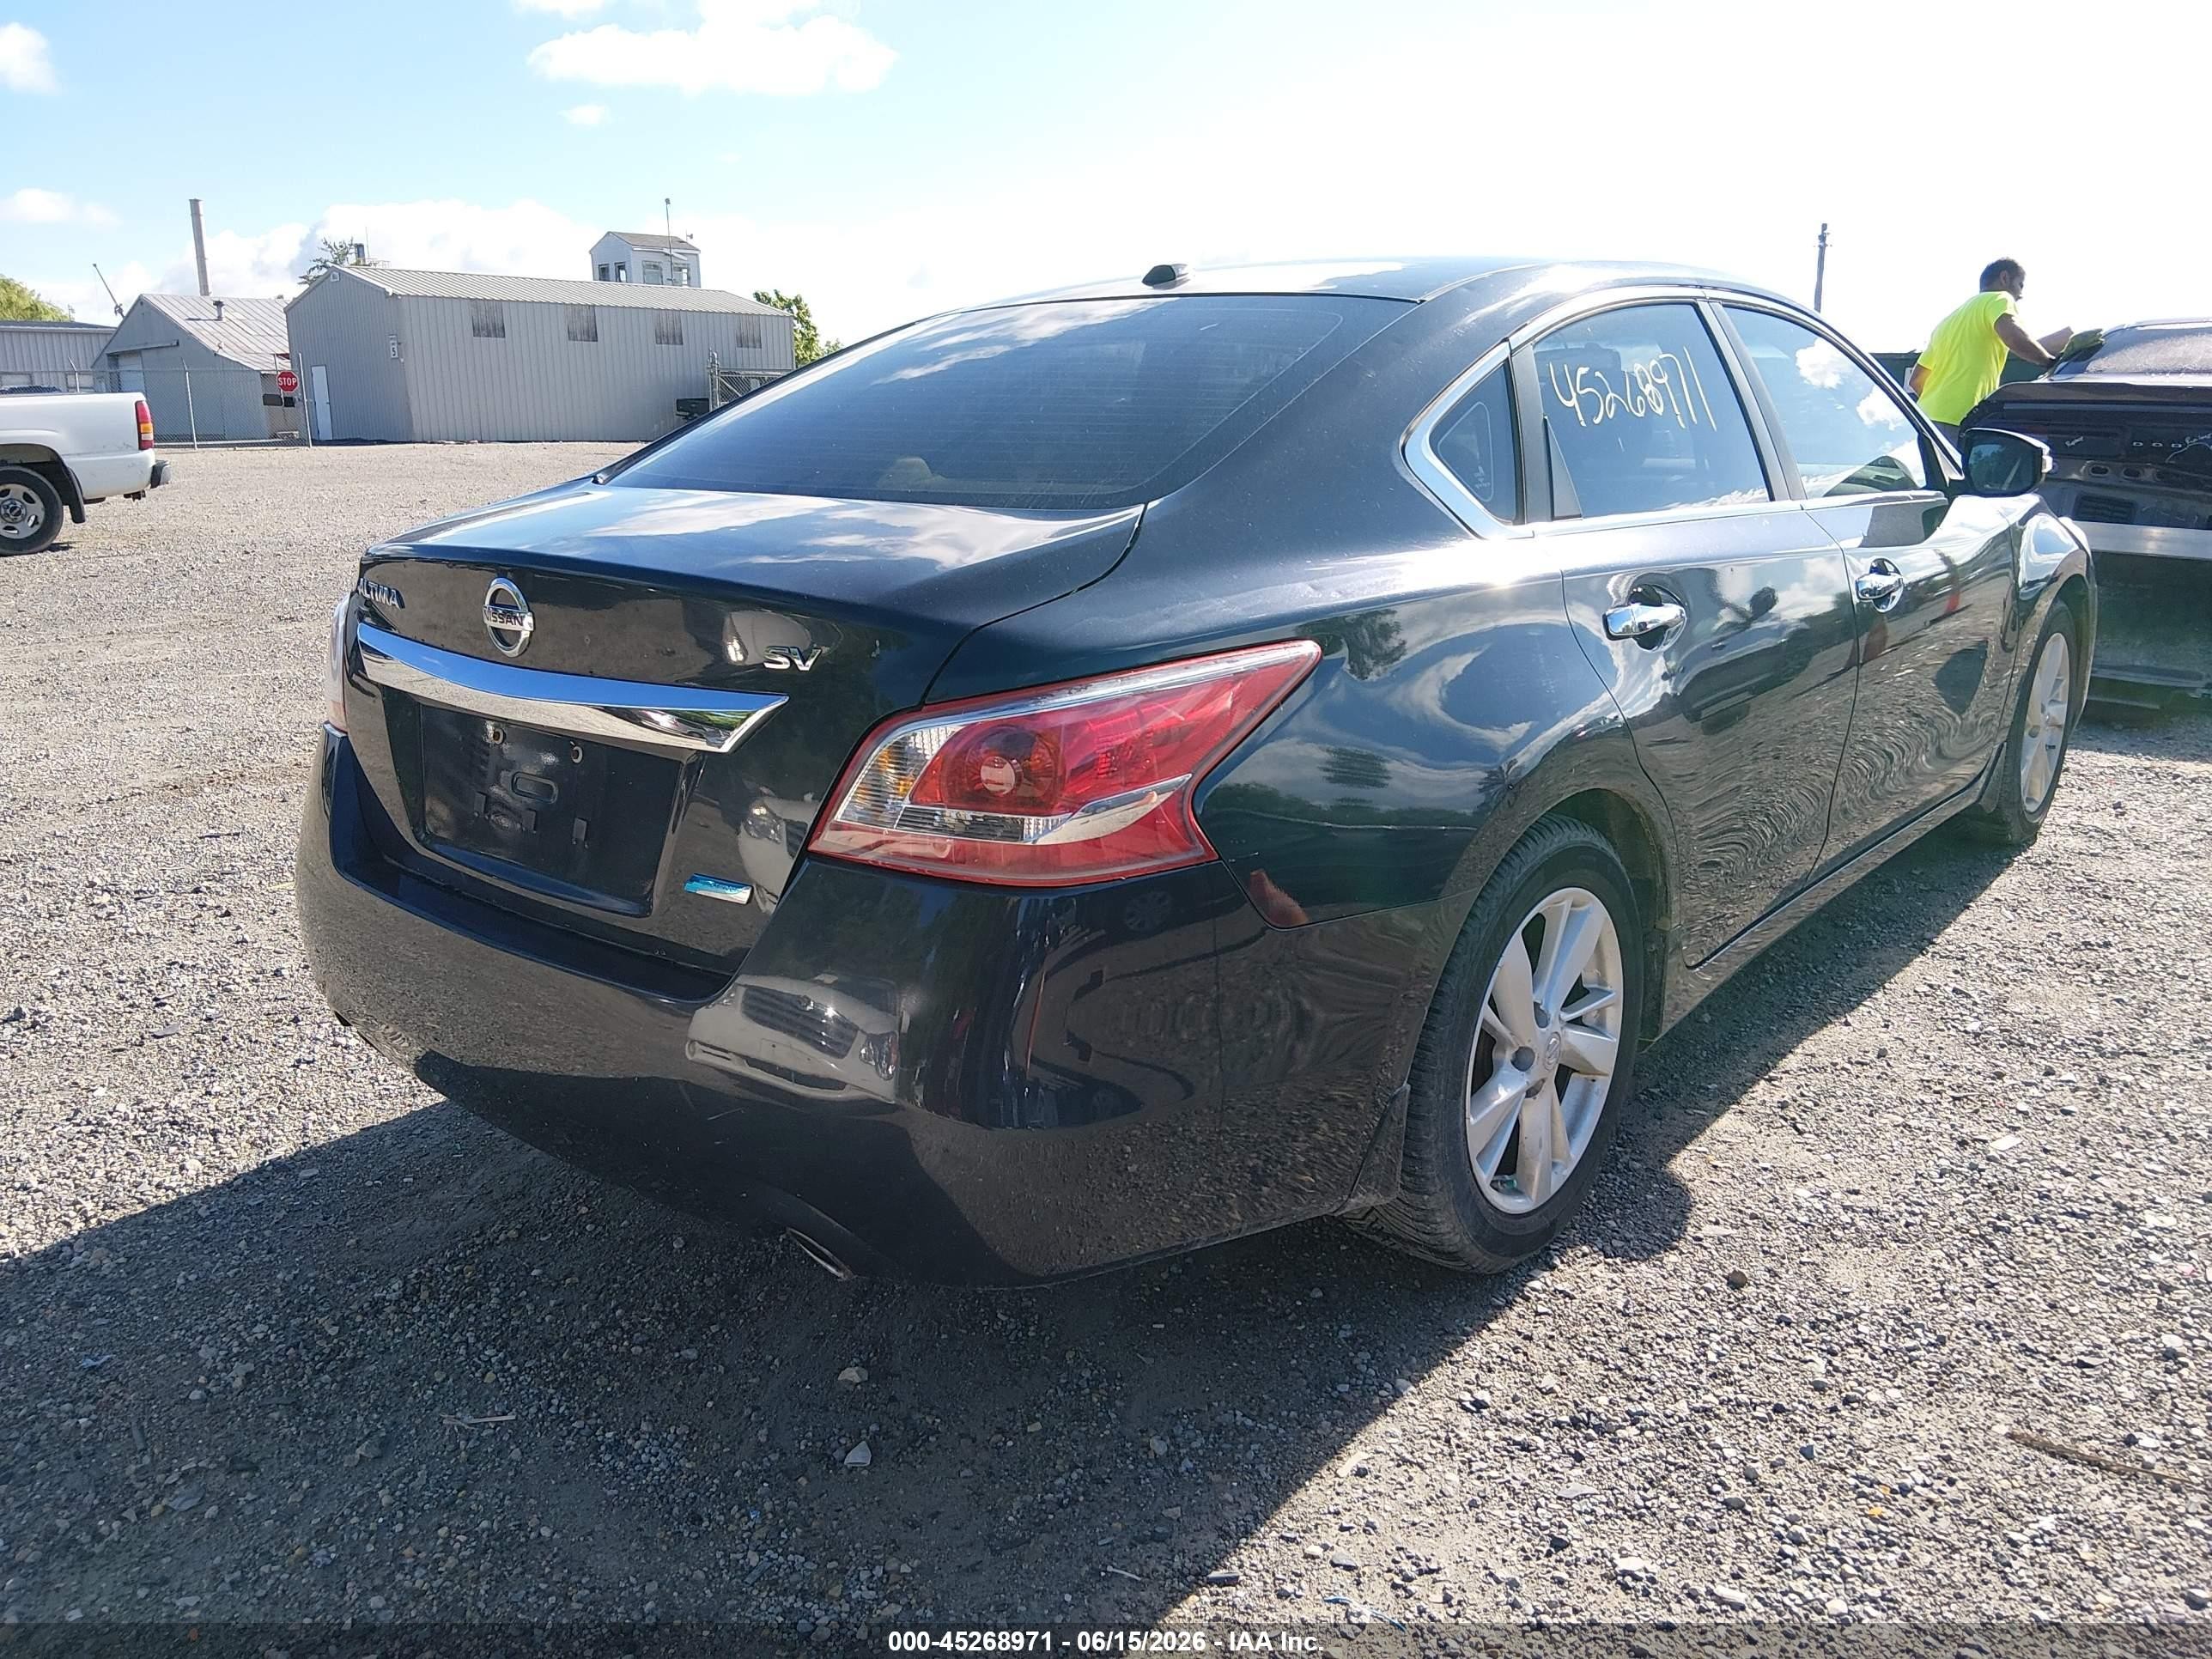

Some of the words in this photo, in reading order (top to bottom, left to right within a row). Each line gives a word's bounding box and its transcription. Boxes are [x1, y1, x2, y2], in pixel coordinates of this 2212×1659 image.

[278, 377, 297, 386] STOP
[1549, 346, 1717, 432] 45268971
[357, 577, 402, 611] ALTIMA
[484, 609, 524, 627] NISSAN
[763, 646, 822, 671] SV
